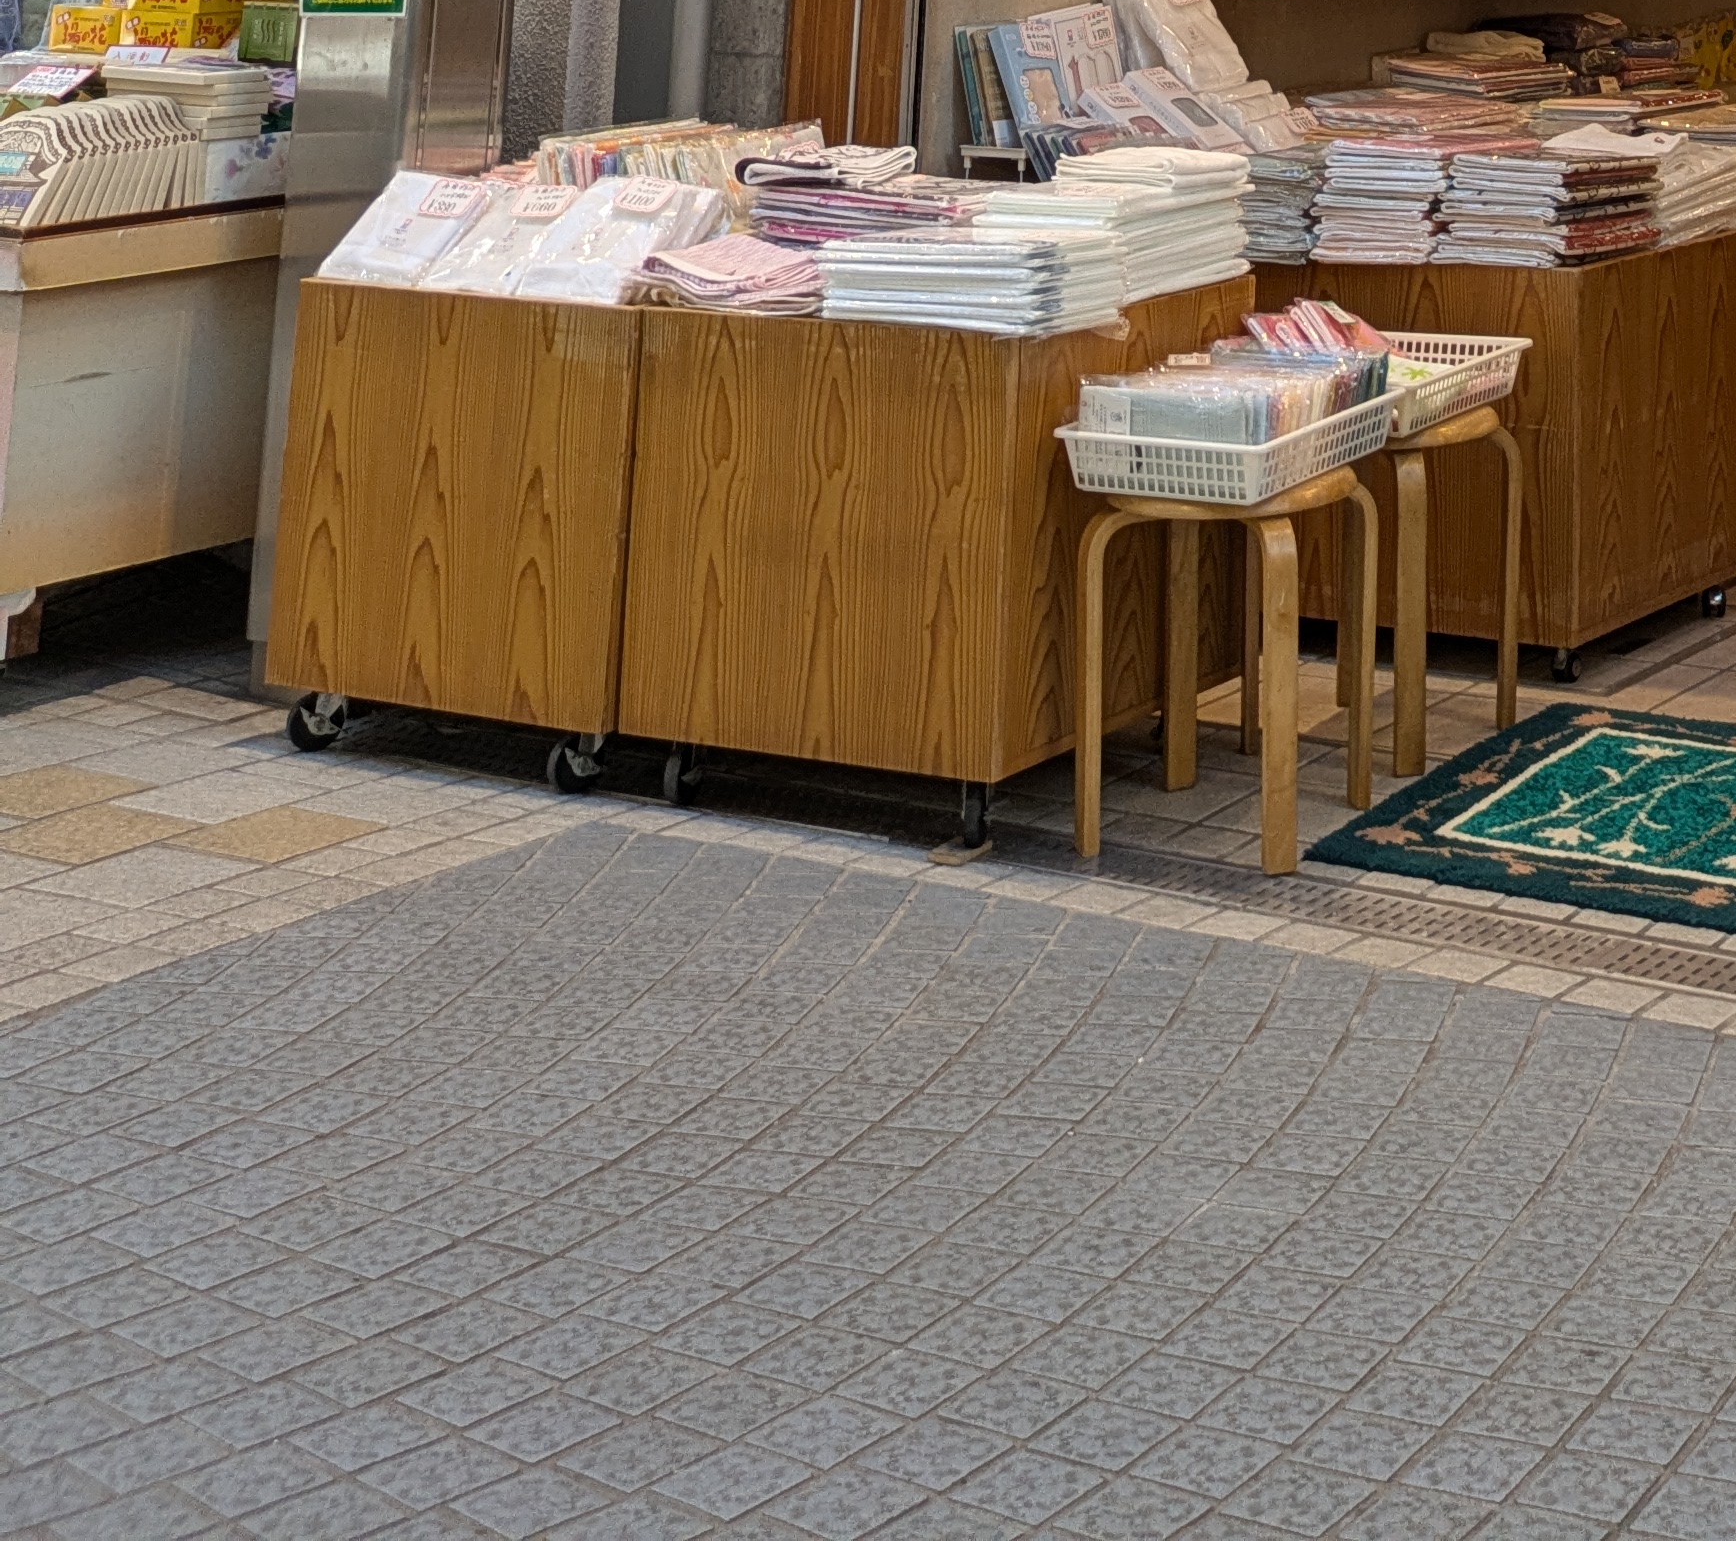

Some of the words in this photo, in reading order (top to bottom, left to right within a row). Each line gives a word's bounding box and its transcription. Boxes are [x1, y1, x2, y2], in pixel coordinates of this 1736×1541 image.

[63, 23, 108, 45] 湯の花
[522, 201, 557, 213] ¥660
[620, 192, 656, 207] ¥1100
